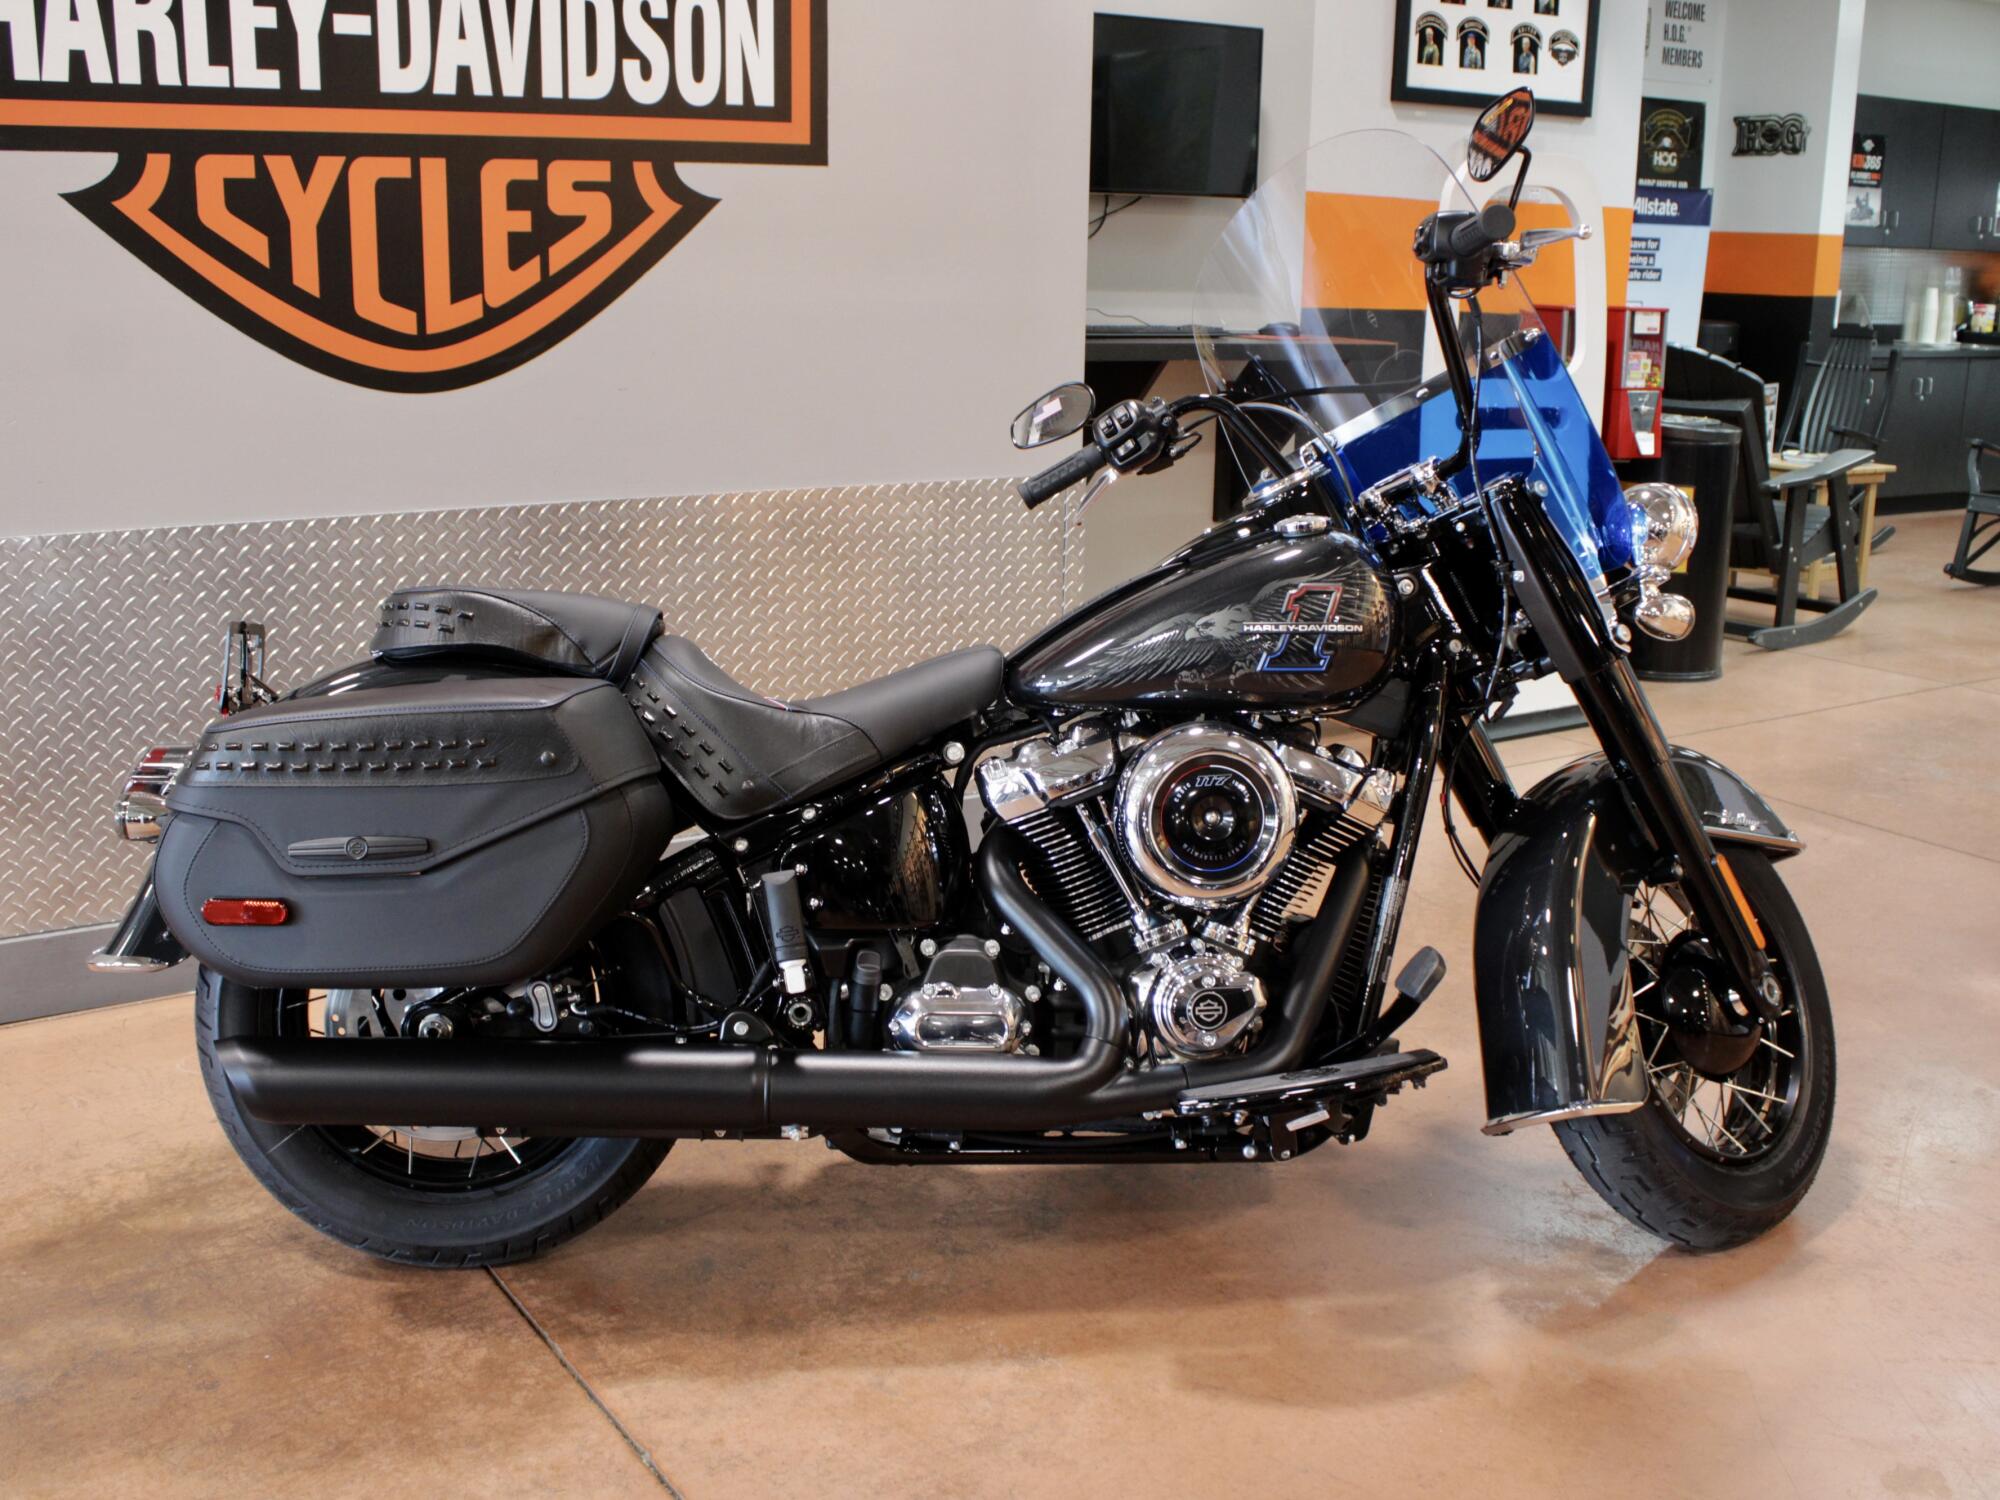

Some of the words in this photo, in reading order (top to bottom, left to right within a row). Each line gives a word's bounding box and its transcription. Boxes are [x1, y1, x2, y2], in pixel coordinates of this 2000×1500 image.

[1665, 0, 1705, 21] WELCOME
[1662, 46, 1703, 68] MEMBERS
[1731, 113, 1809, 156] HOG
[1653, 150, 1677, 166] HOG
[195, 154, 612, 335] CYCLES
[1647, 239, 1659, 249] for
[1642, 269, 1661, 280] rider
[1243, 624, 1363, 632] HARLEY-DAVIDSON
[1195, 773, 1233, 787] 117
